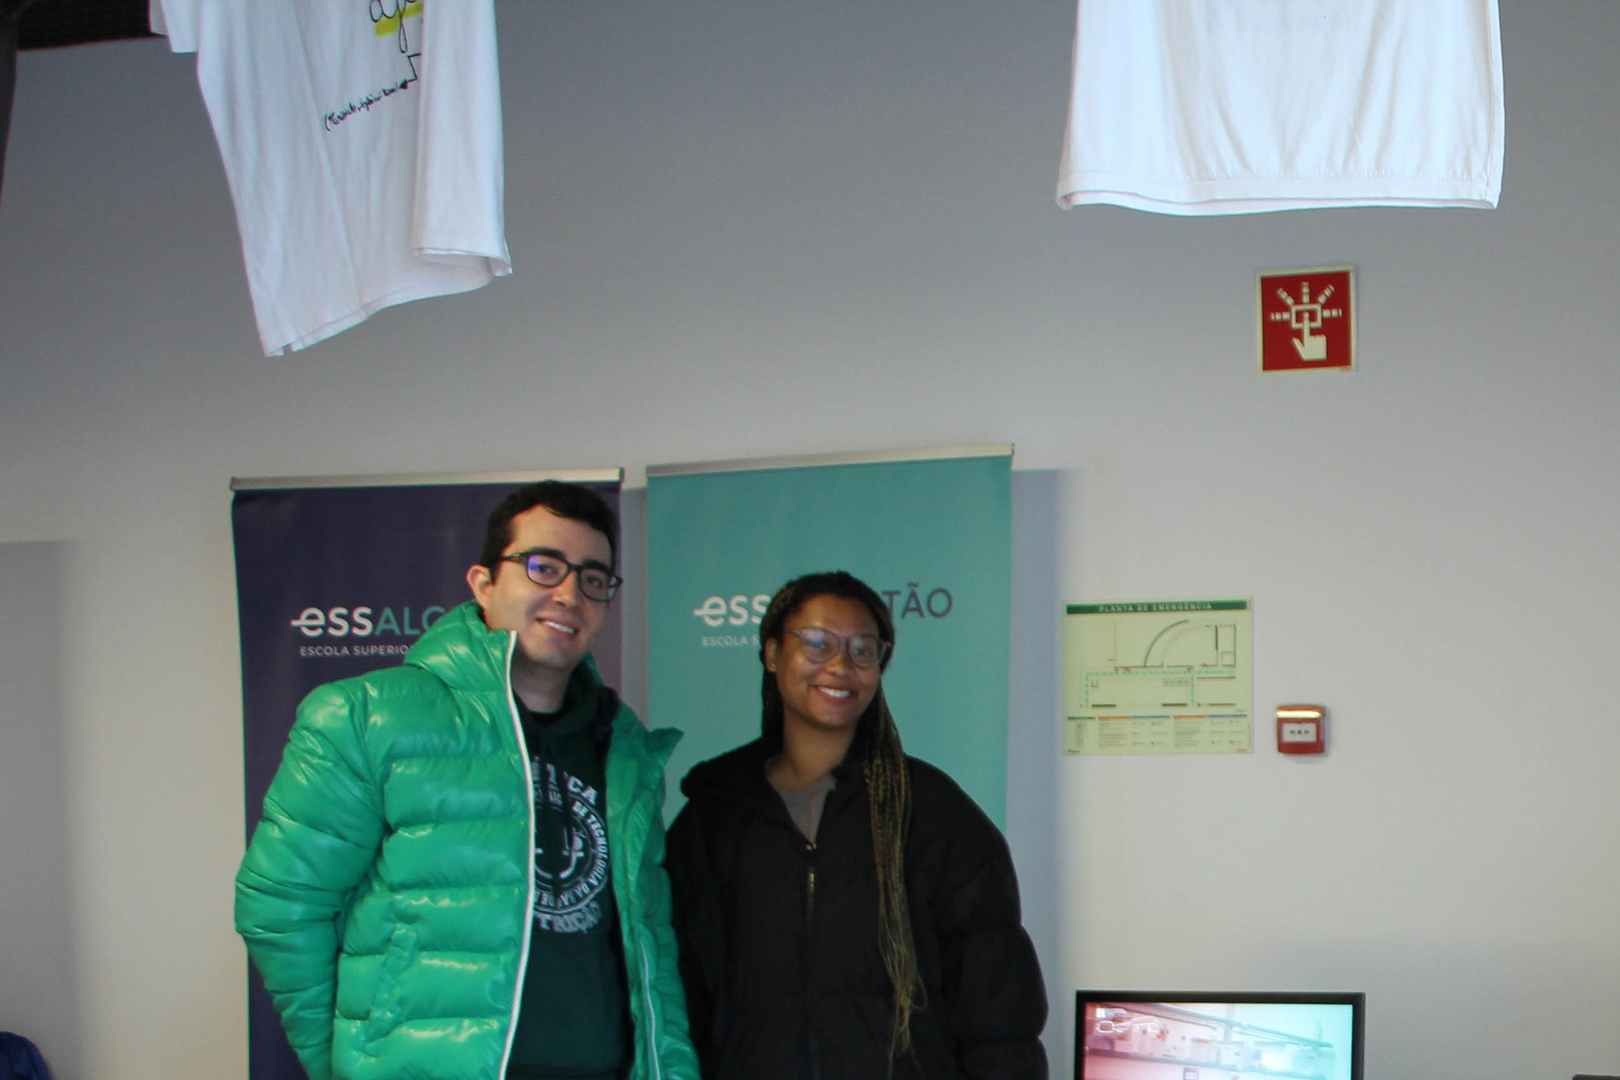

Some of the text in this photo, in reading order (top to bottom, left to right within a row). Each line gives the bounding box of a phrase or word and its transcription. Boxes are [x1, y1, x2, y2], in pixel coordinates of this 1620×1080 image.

[1100, 603, 1134, 613] PLANTA
[1137, 603, 1150, 612] DE
[702, 635, 749, 647] ESCOLA
[300, 644, 414, 657] ESCOLA SUPERIO
